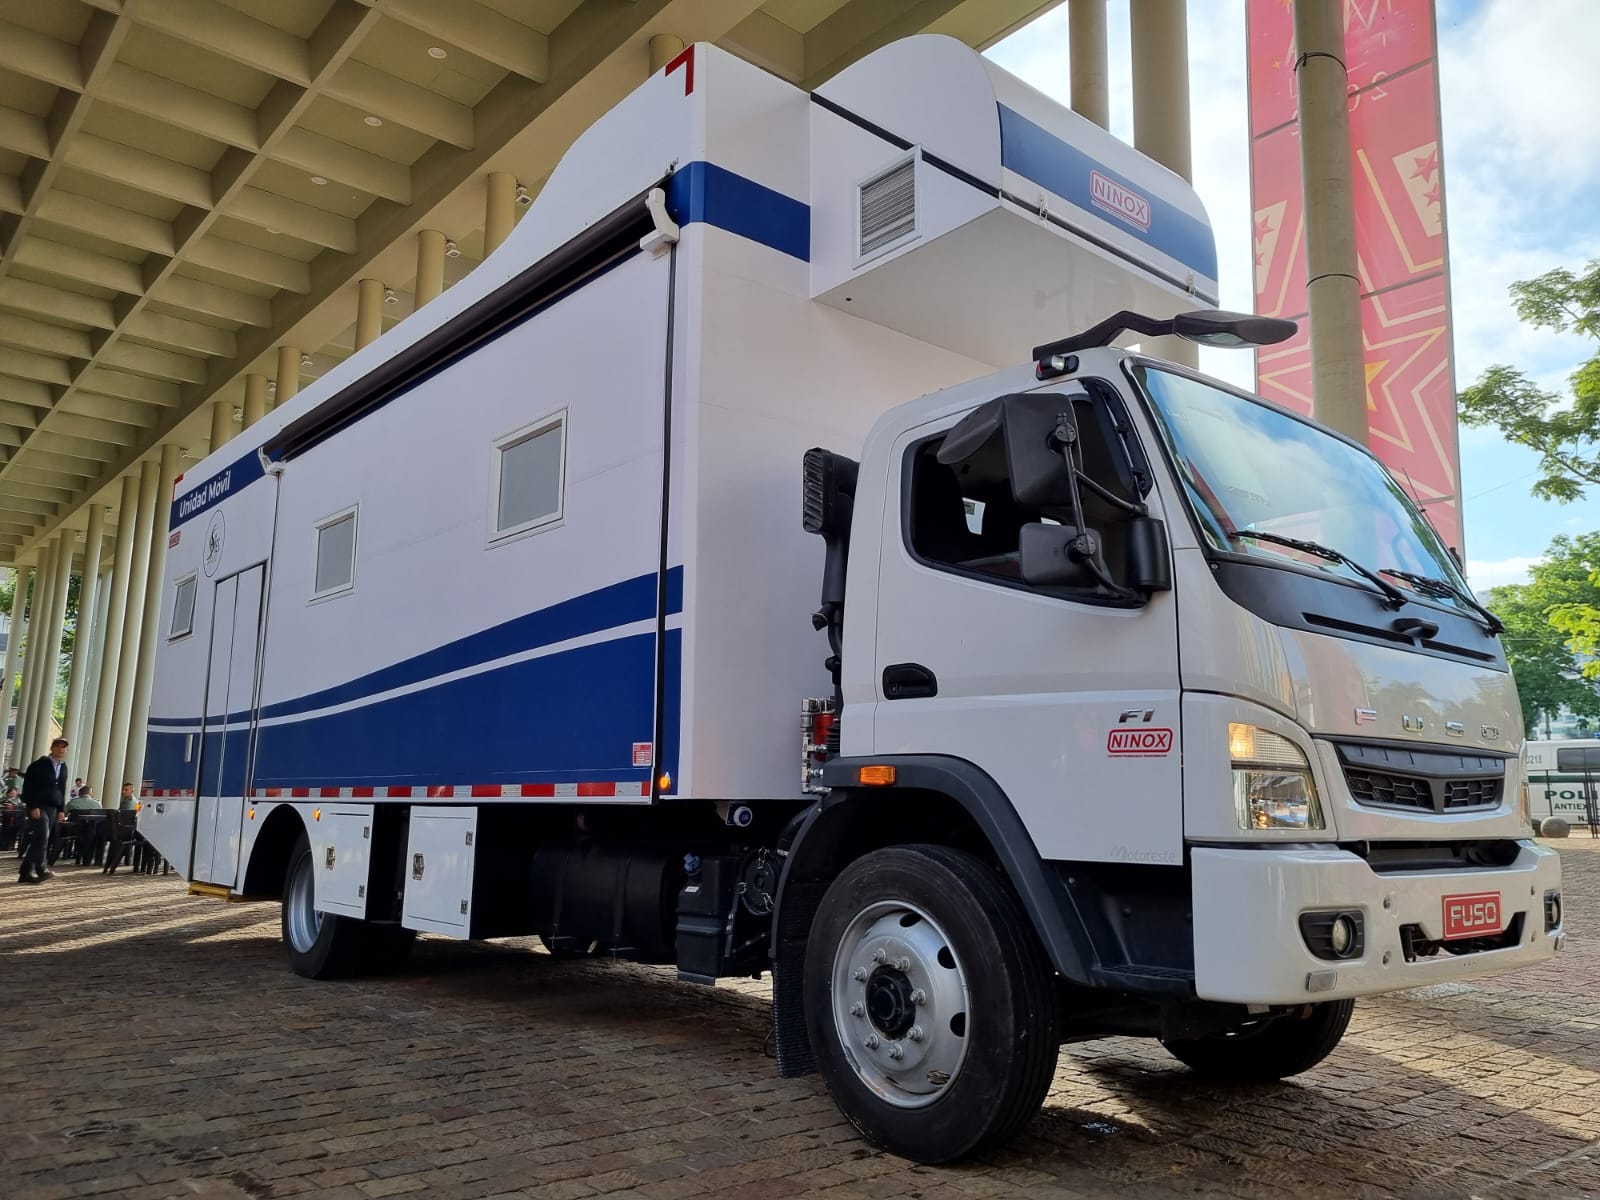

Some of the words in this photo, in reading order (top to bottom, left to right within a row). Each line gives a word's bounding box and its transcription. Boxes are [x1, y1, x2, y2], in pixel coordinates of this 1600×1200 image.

[1094, 178, 1146, 221] NINOX
[179, 485, 208, 518] Unidad
[208, 470, 232, 502] Móvil
[1111, 733, 1168, 748] NINOX
[1354, 707, 1499, 741] FUSO
[1450, 901, 1497, 929] FUSO
